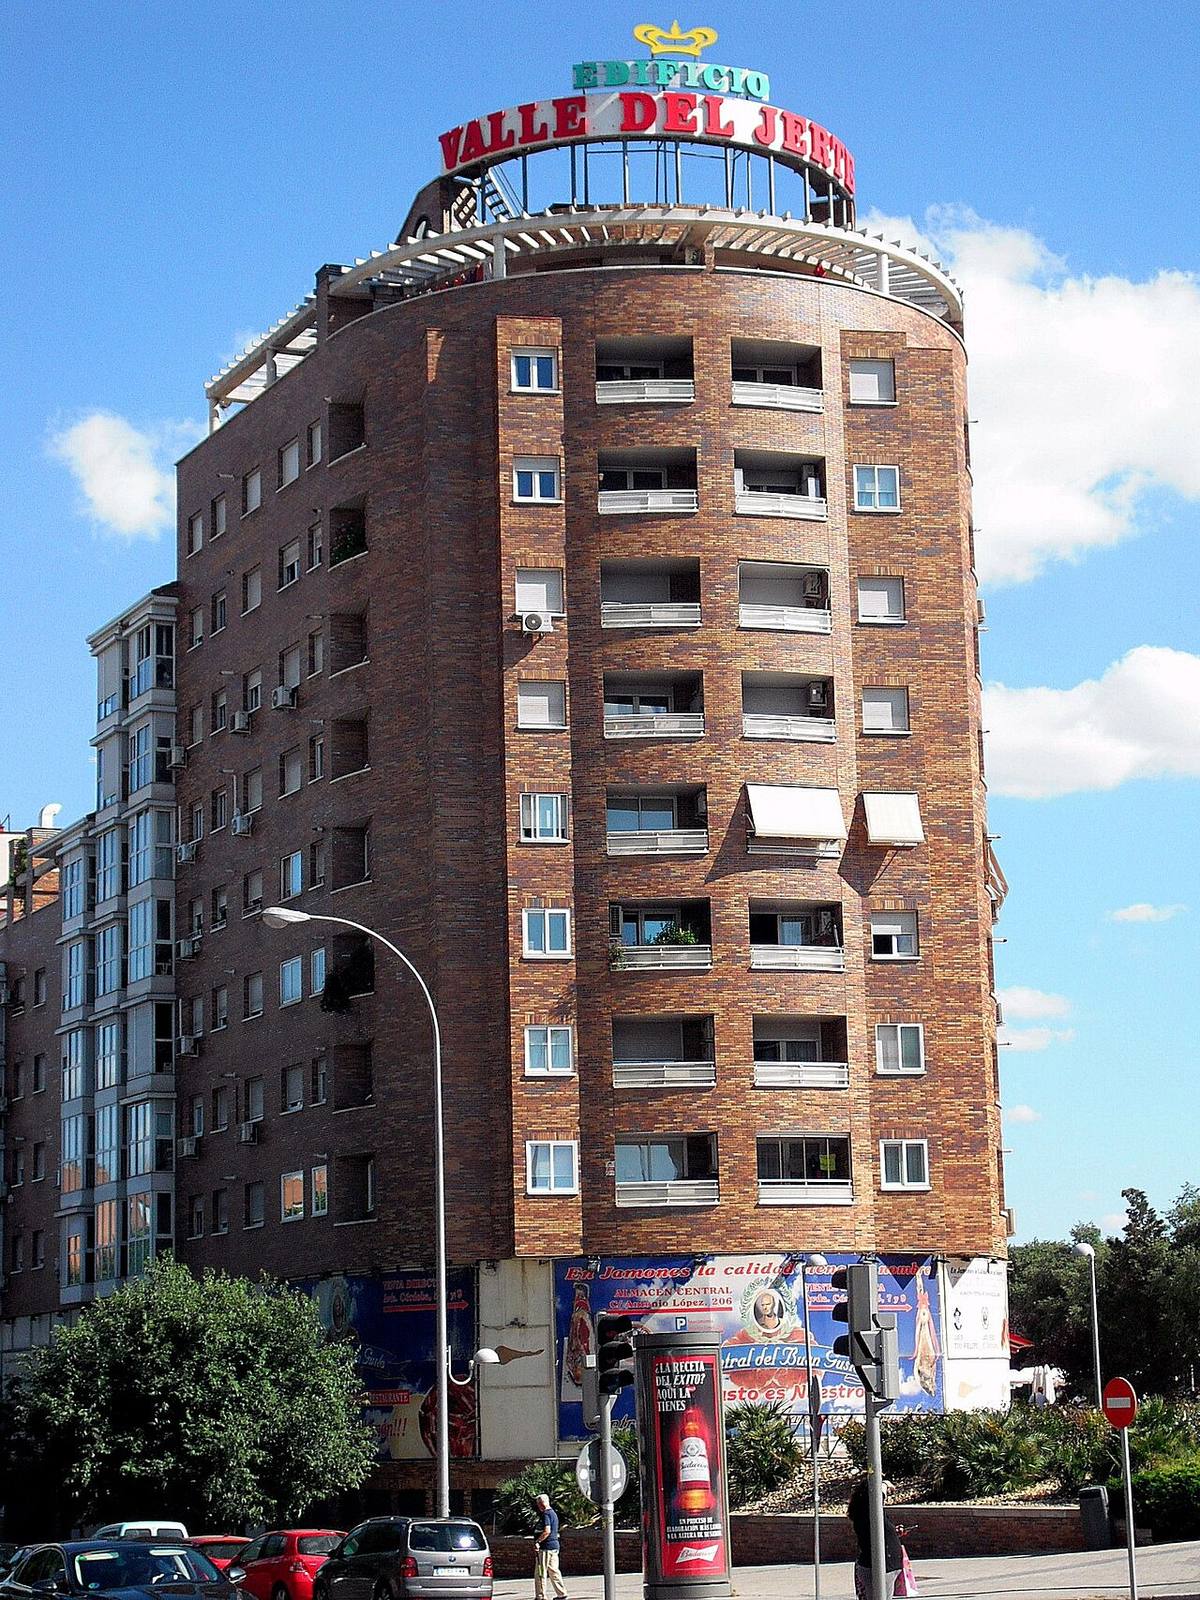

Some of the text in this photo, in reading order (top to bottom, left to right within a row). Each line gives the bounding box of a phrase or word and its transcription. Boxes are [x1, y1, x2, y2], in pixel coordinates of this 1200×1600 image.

[572, 60, 769, 99] EDIFICIO
[438, 91, 855, 195] VALLE DEL JERTE
[565, 1266, 595, 1280] En
[599, 1265, 691, 1281] Jamones
[697, 1264, 716, 1276] la
[723, 1262, 797, 1275] calidad
[675, 1286, 733, 1296] CENTRAL
[711, 1297, 733, 1306] 206
[755, 1345, 779, 1366] del
[823, 1348, 857, 1374] Gus
[673, 1360, 706, 1374] RECETA
[655, 1376, 671, 1387] DEL
[680, 1387, 691, 1399] LA
[765, 1388, 785, 1400] es
[790, 1385, 864, 1401] Nestro
[657, 1399, 686, 1412] TIENES
